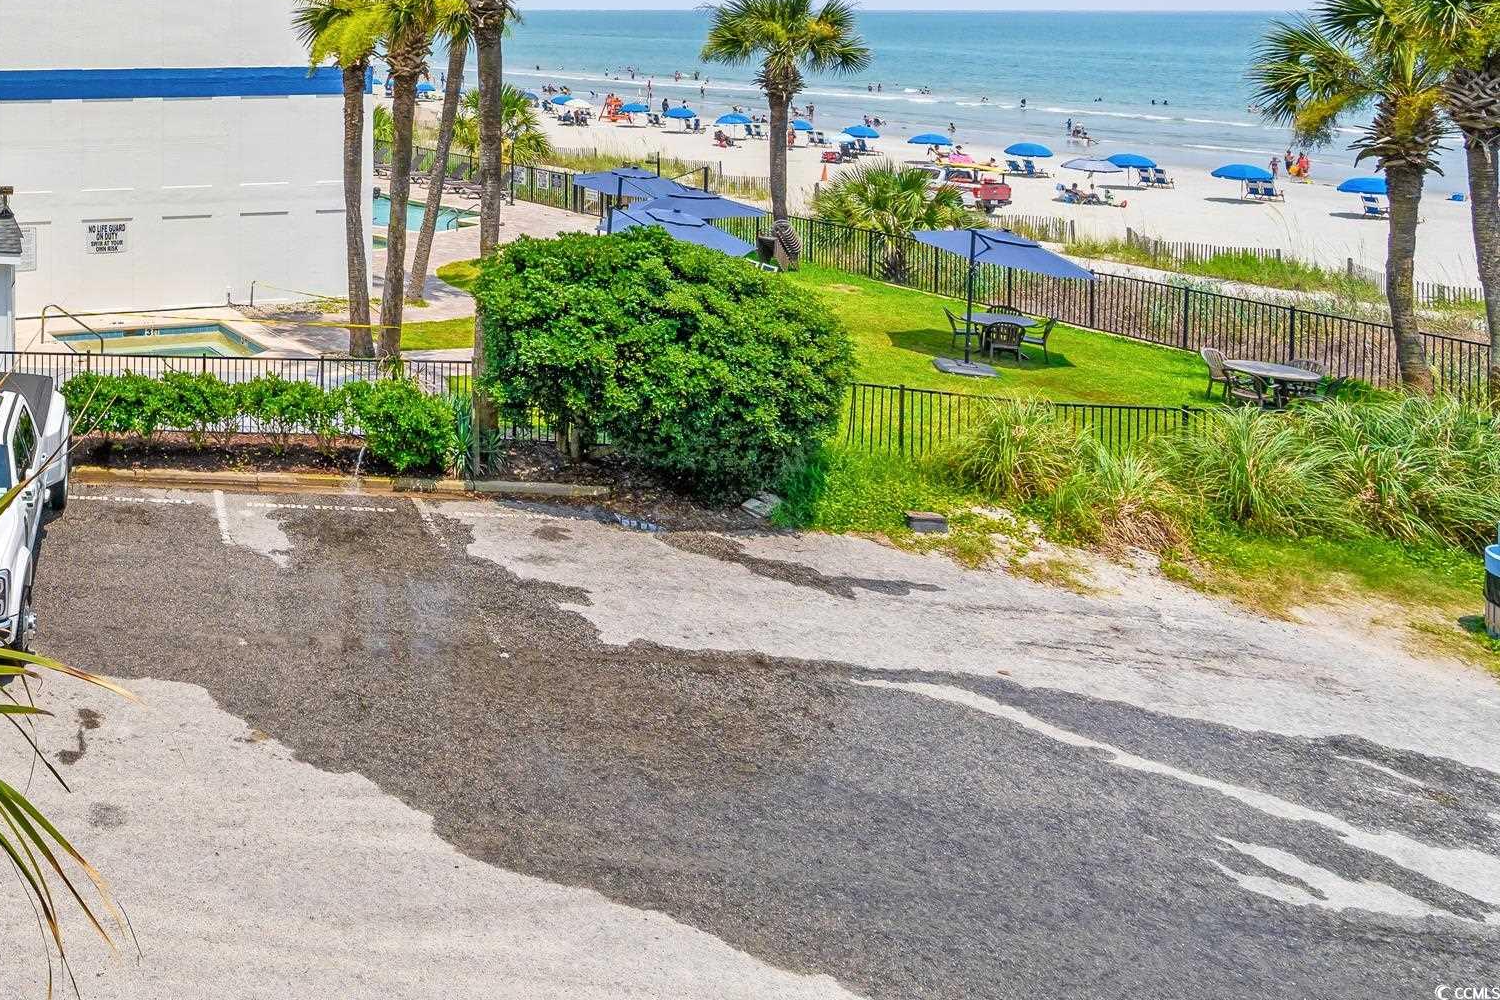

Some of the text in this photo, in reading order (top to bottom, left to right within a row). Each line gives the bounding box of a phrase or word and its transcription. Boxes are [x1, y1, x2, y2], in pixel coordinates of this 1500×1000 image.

[88, 224, 125, 233] NO LIFE GUARD
[105, 232, 118, 240] DUTY
